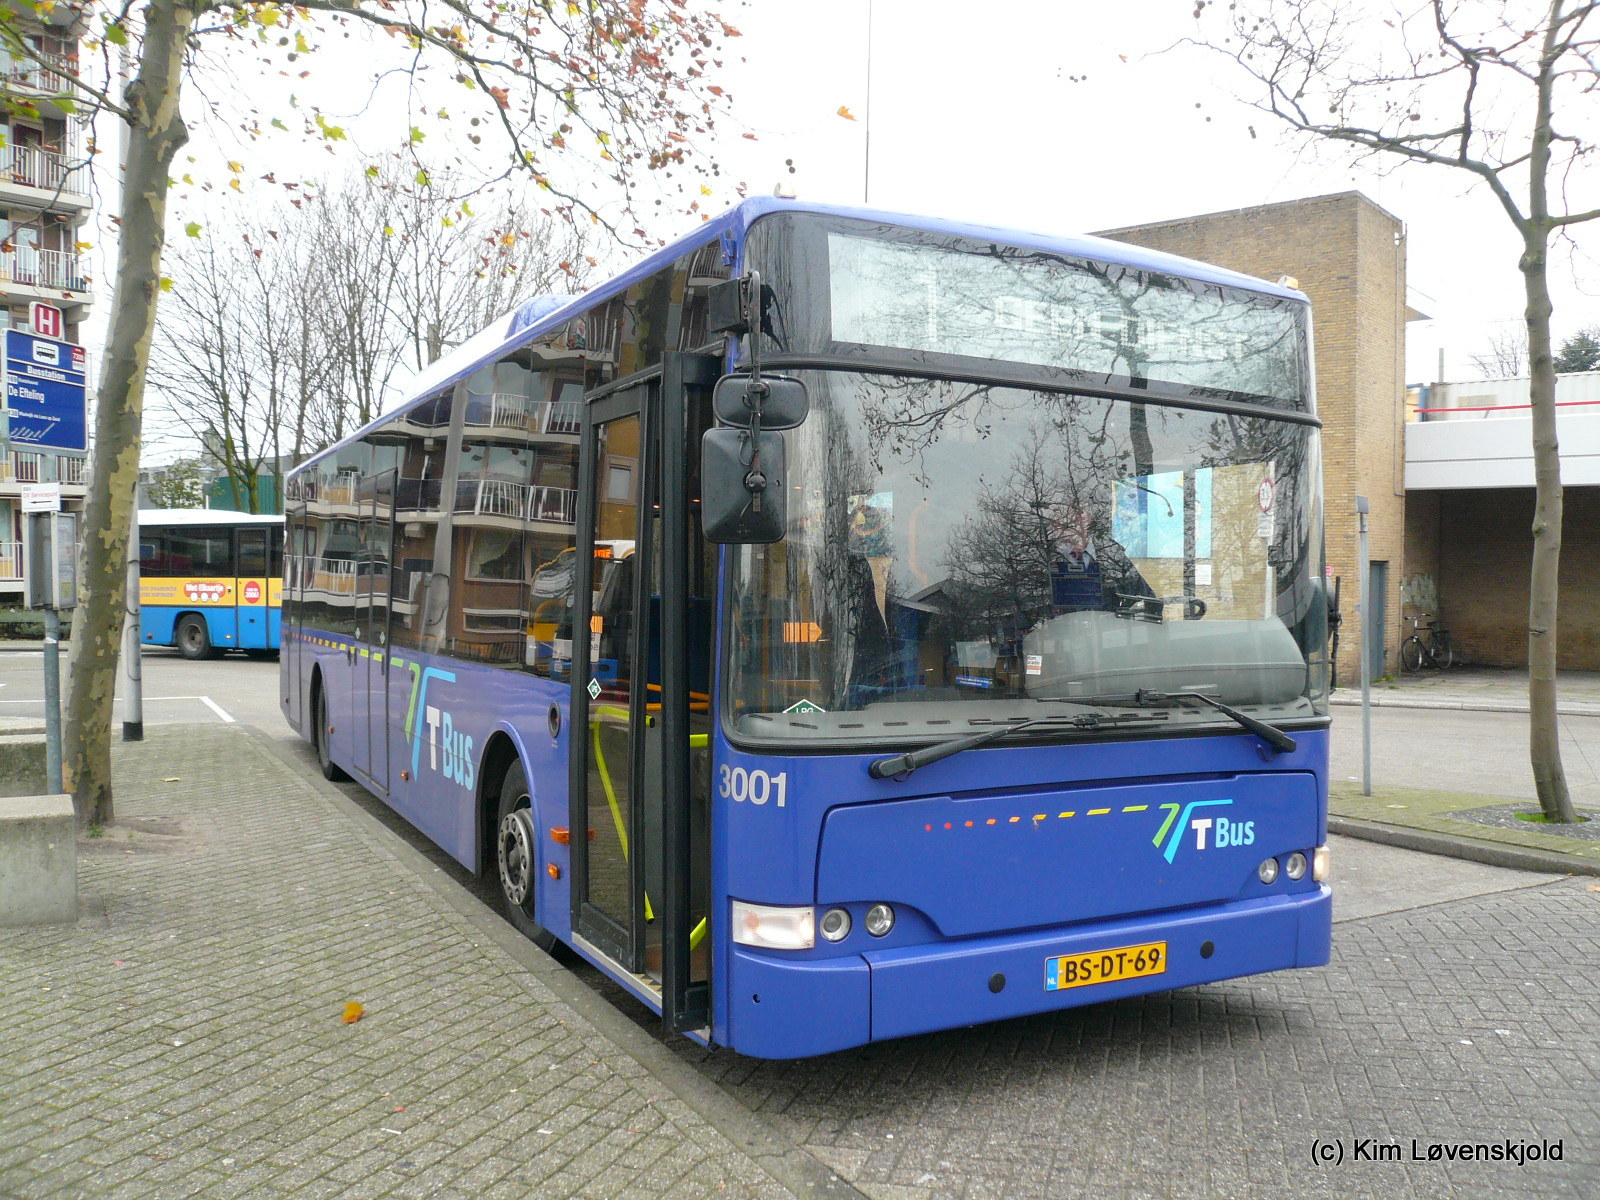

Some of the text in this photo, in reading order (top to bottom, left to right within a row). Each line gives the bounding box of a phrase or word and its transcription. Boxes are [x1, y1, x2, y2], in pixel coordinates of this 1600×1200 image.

[39, 307, 53, 335] H
[27, 366, 66, 381] Busstation
[8, 386, 45, 404] De Efteling
[185, 584, 198, 592] Met
[427, 705, 474, 791] T Bus
[719, 763, 787, 808] 3001
[1191, 817, 1255, 850] T Bus
[1047, 947, 1161, 986] NL BS-DT-69
